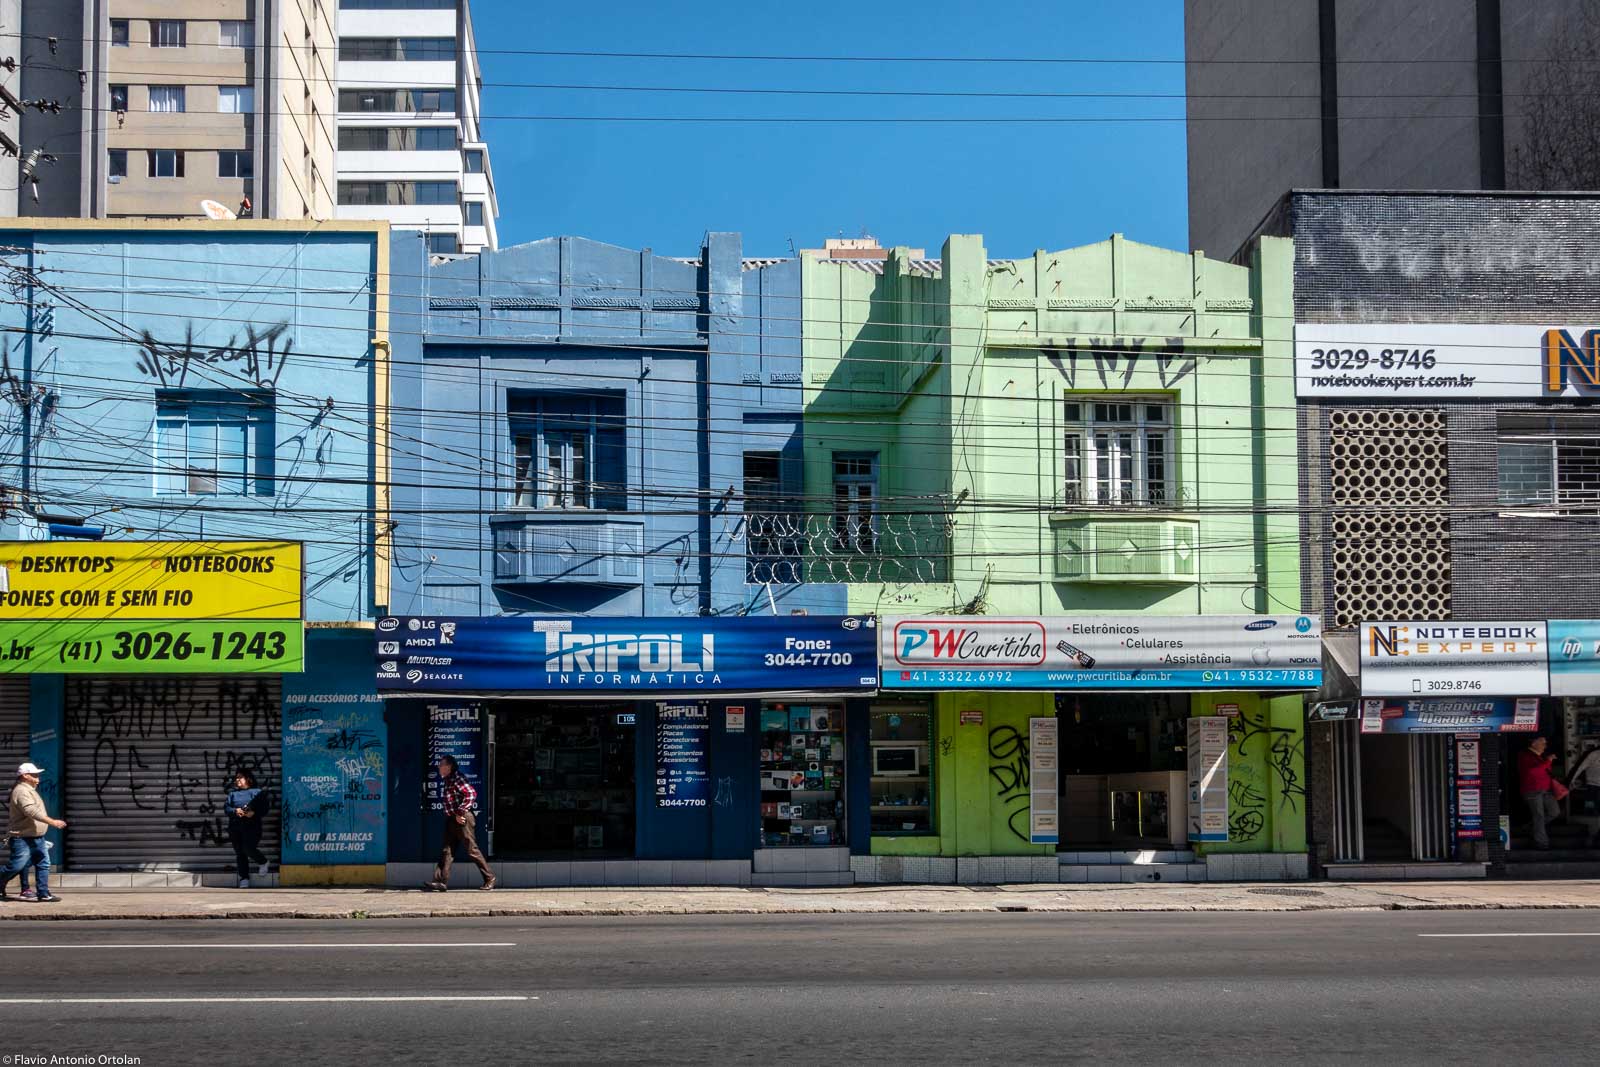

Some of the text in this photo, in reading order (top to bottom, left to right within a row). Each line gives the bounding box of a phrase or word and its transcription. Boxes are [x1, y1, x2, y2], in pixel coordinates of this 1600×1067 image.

[1310, 349, 1436, 370] 3029-8746
[1311, 374, 1475, 391] notebookexpert.com.br
[20, 556, 275, 573] DESKTOPS NOTEBOOKS
[60, 590, 100, 606] COM
[105, 590, 116, 606] E
[121, 590, 158, 606] SEM
[163, 590, 193, 606] FIO
[422, 621, 436, 629] LG
[1072, 623, 1140, 635] Eletrônicos
[1416, 628, 1537, 639] NOTEBOOK
[59, 640, 103, 664] (41)
[112, 631, 286, 661] 3026-1243
[533, 620, 714, 672] TRIPOLI
[785, 637, 831, 650] Fone:
[1126, 638, 1184, 649] Celulares
[1416, 643, 1537, 653] EXPERT
[1562, 638, 1582, 661] hp
[764, 653, 852, 666] 3044-7700
[1164, 653, 1232, 664] Assistência
[548, 673, 721, 684] INFORMÁTICA
[1047, 671, 1173, 683] www.pwcuritiba.com.br
[1427, 680, 1482, 691] 3029.8746
[286, 694, 307, 703] AQUI
[308, 692, 359, 703] ACESSÓRIOS
[660, 799, 706, 807] 3044-7700
[296, 833, 373, 841] E OUTAS MARCAS
[304, 843, 366, 851] CONSULTE-NOS
